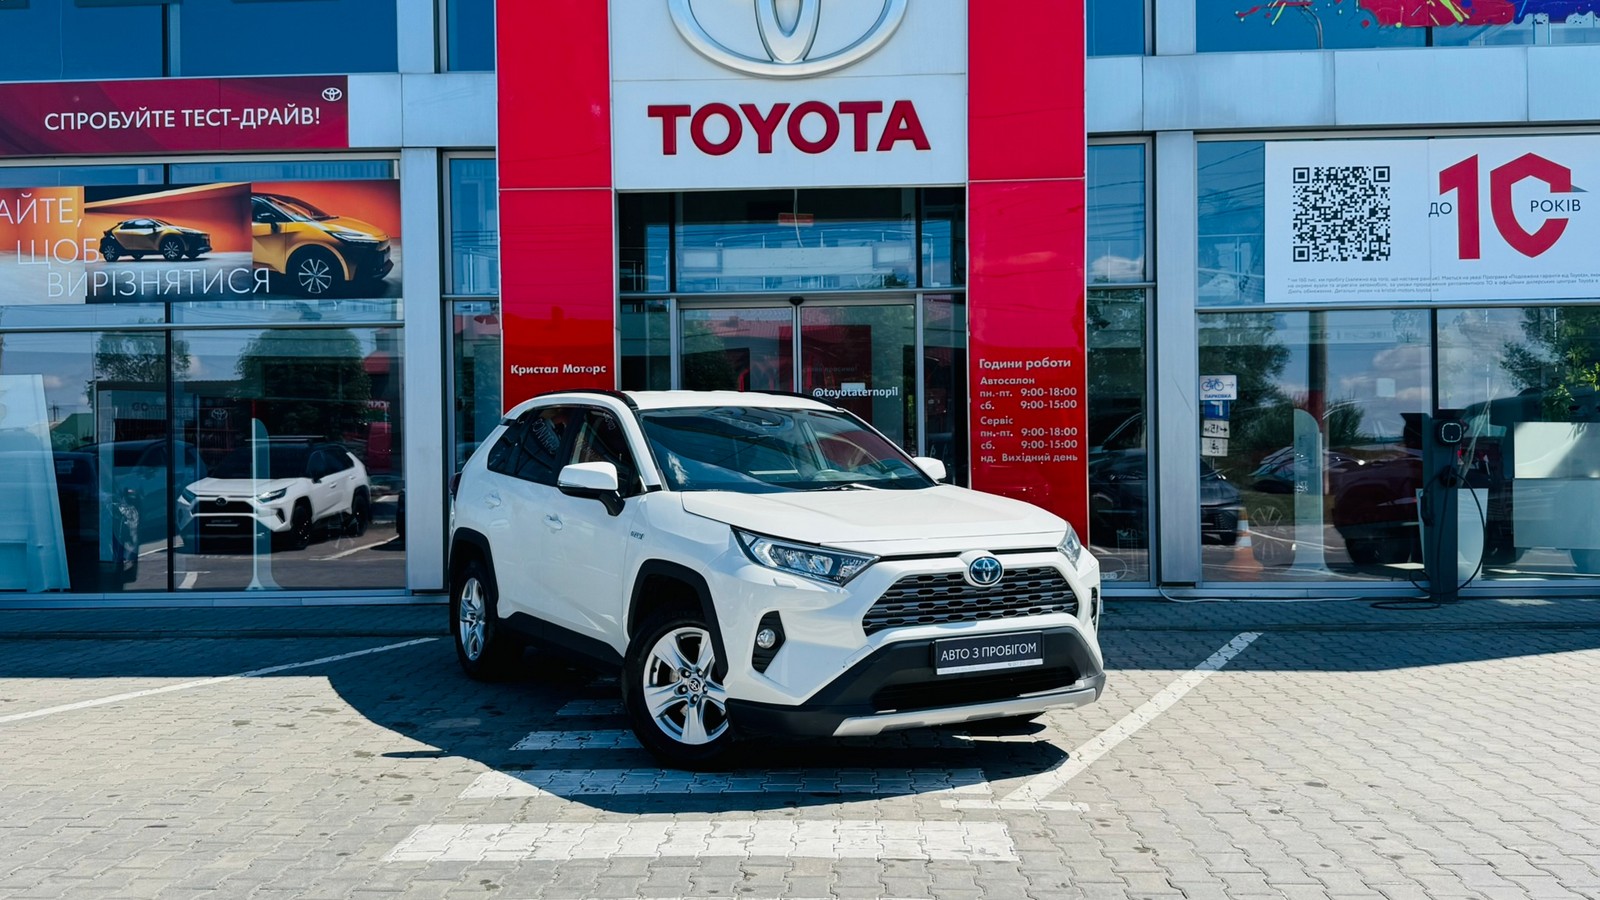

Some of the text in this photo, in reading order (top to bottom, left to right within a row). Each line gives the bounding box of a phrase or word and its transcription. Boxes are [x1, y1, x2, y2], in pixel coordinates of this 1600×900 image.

[44, 103, 320, 131] СПРОБУЙТЕ ТЕСТ-ДРАЙВ!
[648, 100, 931, 156] TOYOTA
[1428, 202, 1452, 217] ДО
[1530, 199, 1581, 213] РОКІВ
[17, 238, 99, 270] ЩОБ
[47, 268, 270, 298] ВИРІЗНЯТИСЯ
[510, 363, 607, 376] Кристал Моторс
[979, 357, 1071, 370] Години роботи
[980, 376, 1035, 385] Автосалон
[812, 386, 899, 399] @toyotaternopil
[980, 387, 1077, 397] пн.-пт. 9:00-18:00
[980, 400, 1077, 410] сб. 9:00-15:00
[980, 415, 1014, 427] Сервіс
[980, 427, 1078, 437] пн.-пт. 9:00-18:00
[980, 439, 1078, 450] сб. 9:00-15:00
[980, 452, 1078, 463] нд. Вихідний день
[940, 642, 1037, 661] АВТО З ПРОБІГОМ
